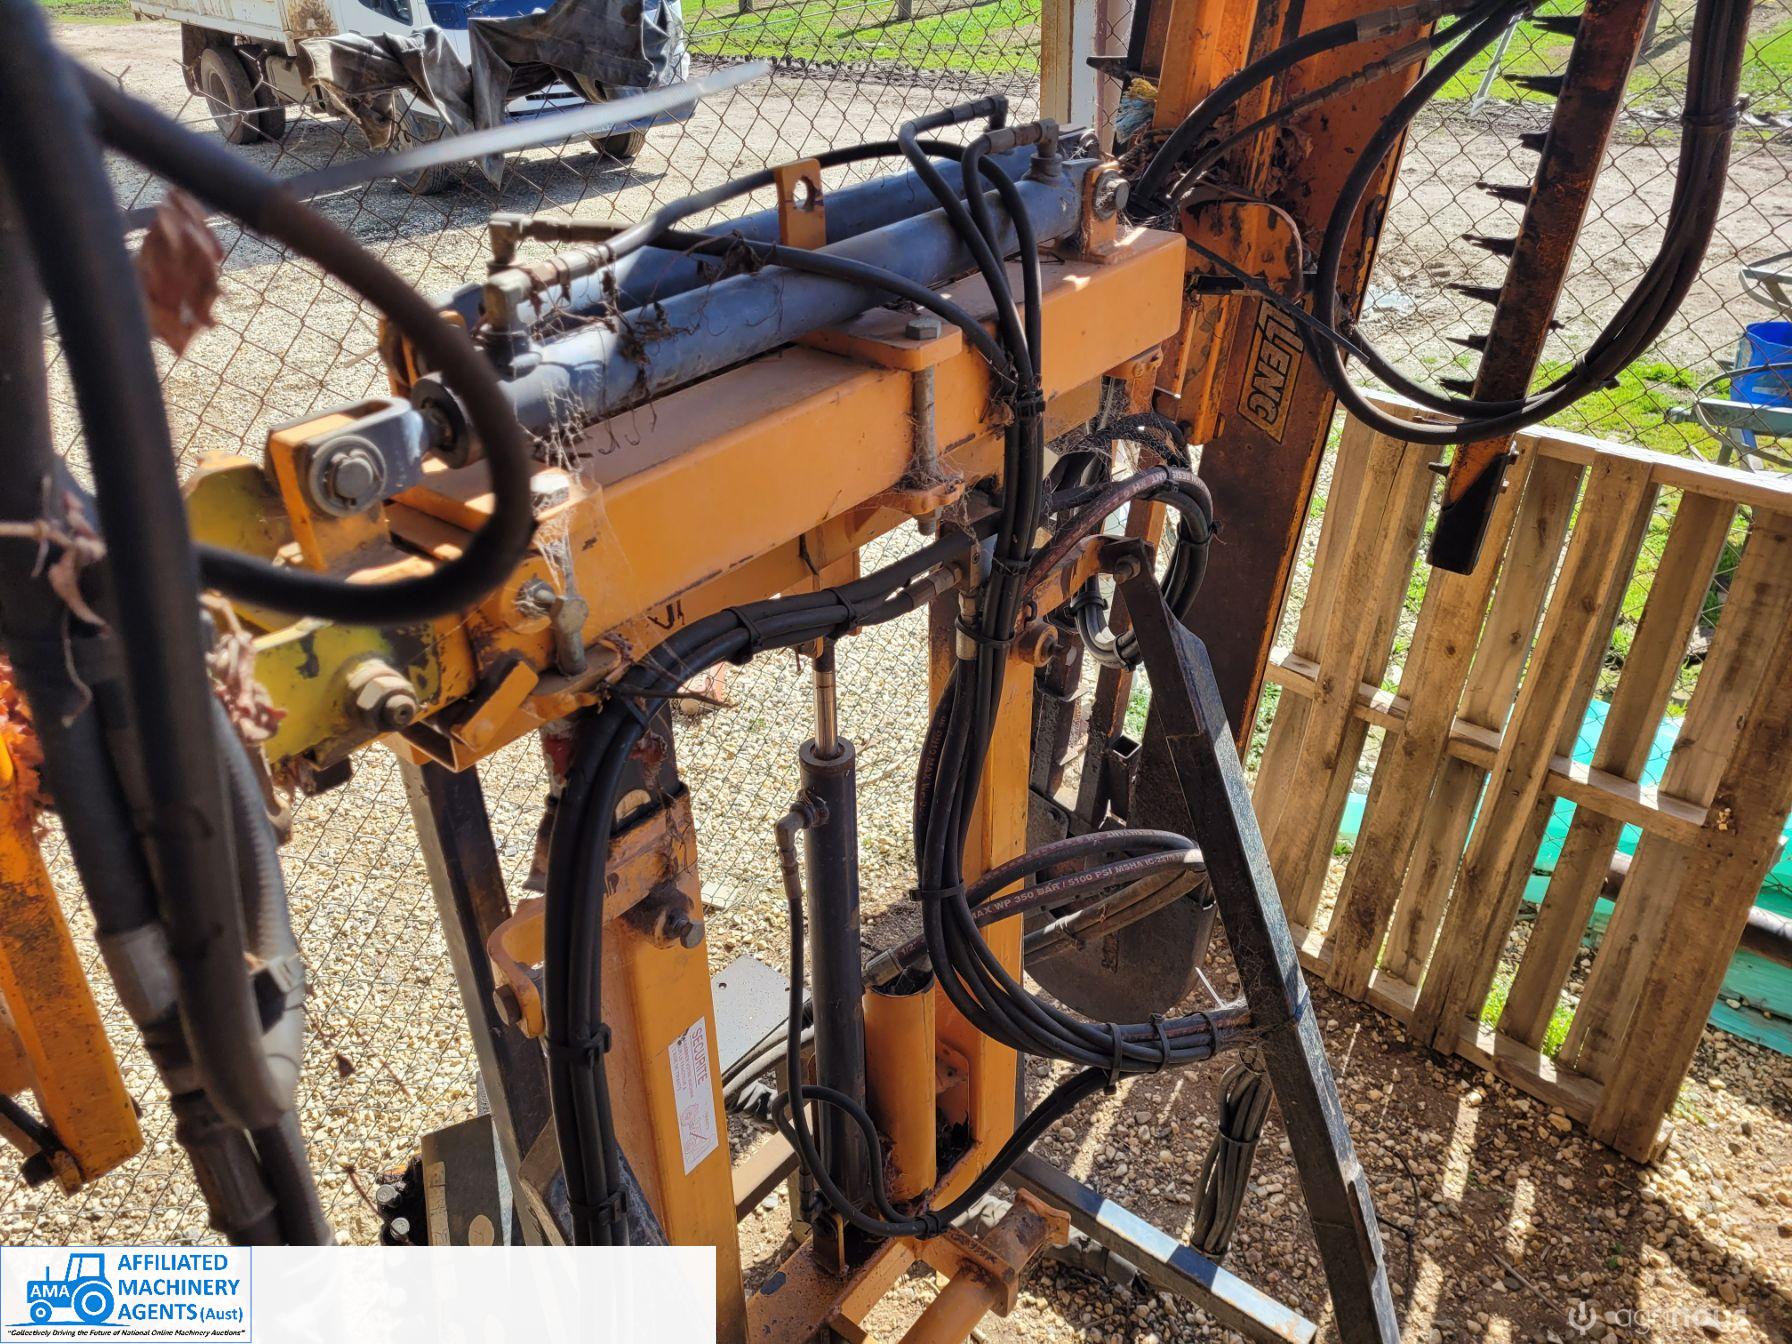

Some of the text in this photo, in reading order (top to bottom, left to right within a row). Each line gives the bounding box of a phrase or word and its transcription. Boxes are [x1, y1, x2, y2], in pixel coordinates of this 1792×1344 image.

[1246, 298, 1304, 426] LLENC
[1014, 891, 1035, 904] 350
[1036, 882, 1061, 897] BAR
[1068, 873, 1093, 887] 5100
[1095, 866, 1113, 879] PSI
[692, 1027, 708, 1086] SECURITE
